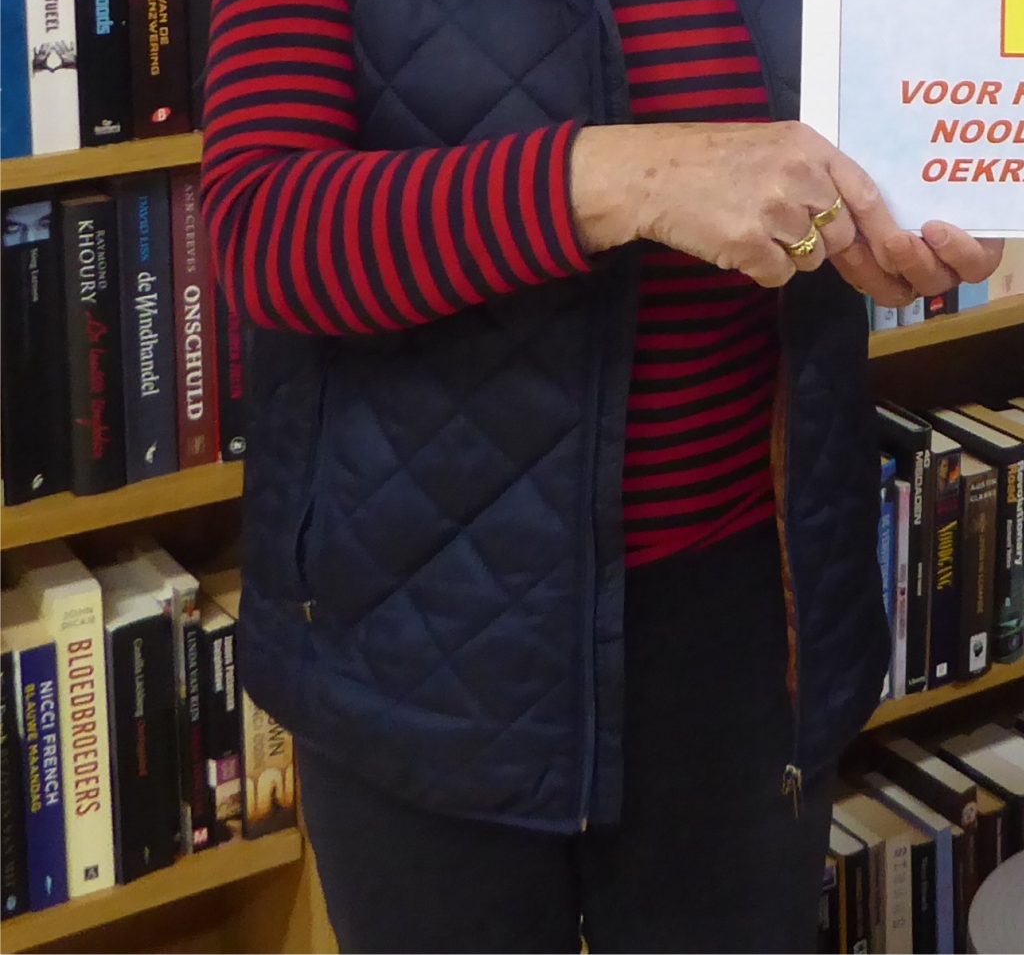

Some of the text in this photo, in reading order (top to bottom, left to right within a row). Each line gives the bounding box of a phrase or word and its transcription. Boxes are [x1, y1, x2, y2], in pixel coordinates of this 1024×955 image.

[159, 26, 169, 45] DE
[900, 80, 1003, 105] VOOR
[77, 219, 97, 304] KHOURY
[95, 229, 108, 290] RAYMOND
[183, 183, 197, 272] ANN CLEEVES
[133, 271, 160, 397] de Windhandel
[182, 284, 204, 421] ONSCHULD
[913, 450, 925, 525] MISDADEN
[1006, 463, 1019, 504] Road
[186, 631, 198, 666] LINDA
[188, 666, 199, 693] VAN
[38, 680, 59, 806] NICCI FRENCH
[67, 638, 101, 817] BLOEDBROEDERS
[27, 743, 40, 813] MAANDAG
